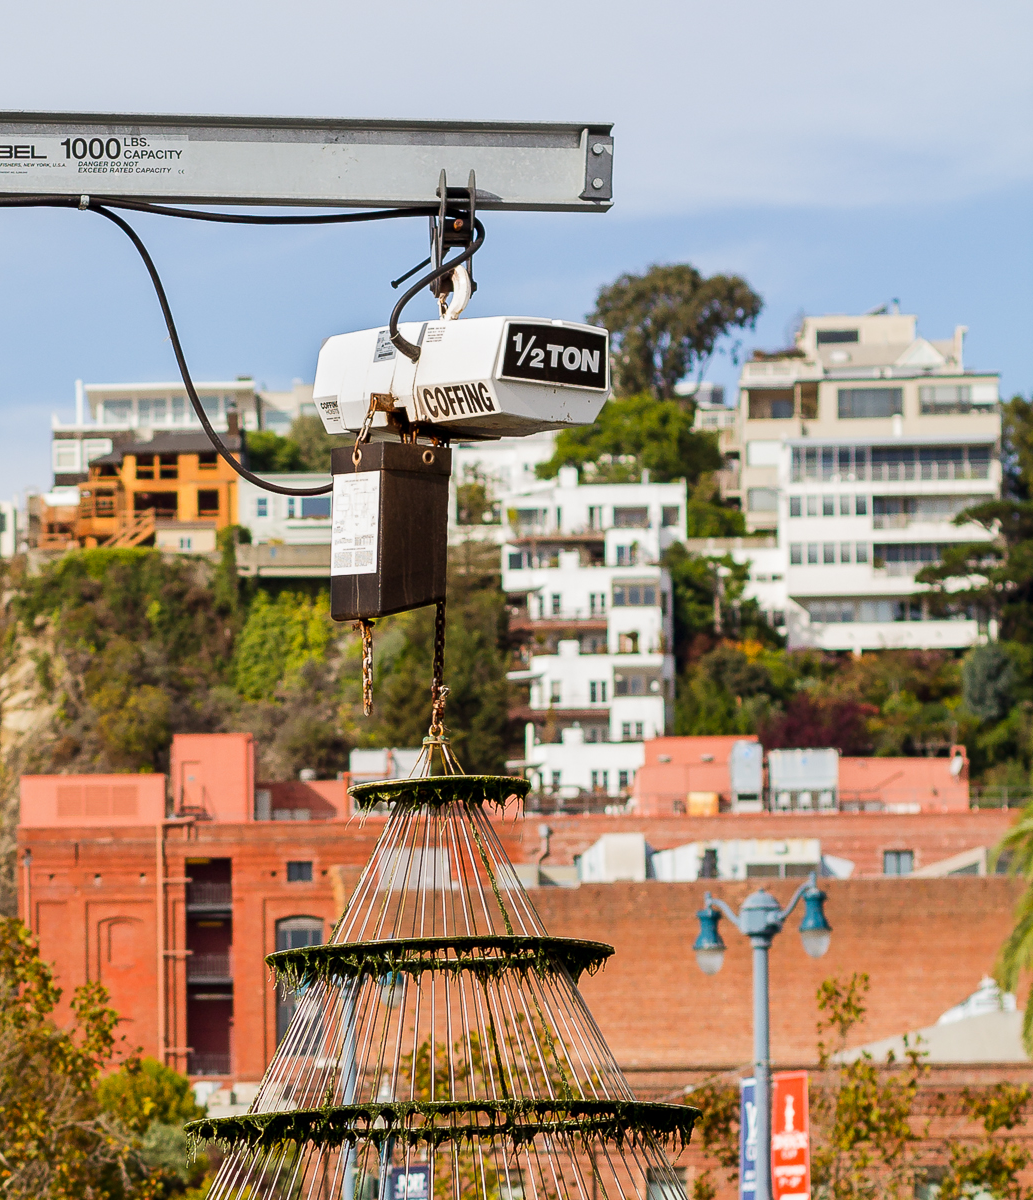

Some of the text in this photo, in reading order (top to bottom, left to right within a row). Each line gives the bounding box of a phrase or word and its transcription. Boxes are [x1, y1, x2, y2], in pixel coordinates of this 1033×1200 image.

[60, 137, 121, 160] 1000
[123, 137, 150, 147] LBS.
[123, 149, 183, 160] CAPACITY
[546, 343, 600, 373] TON
[422, 382, 496, 419] COFFING
